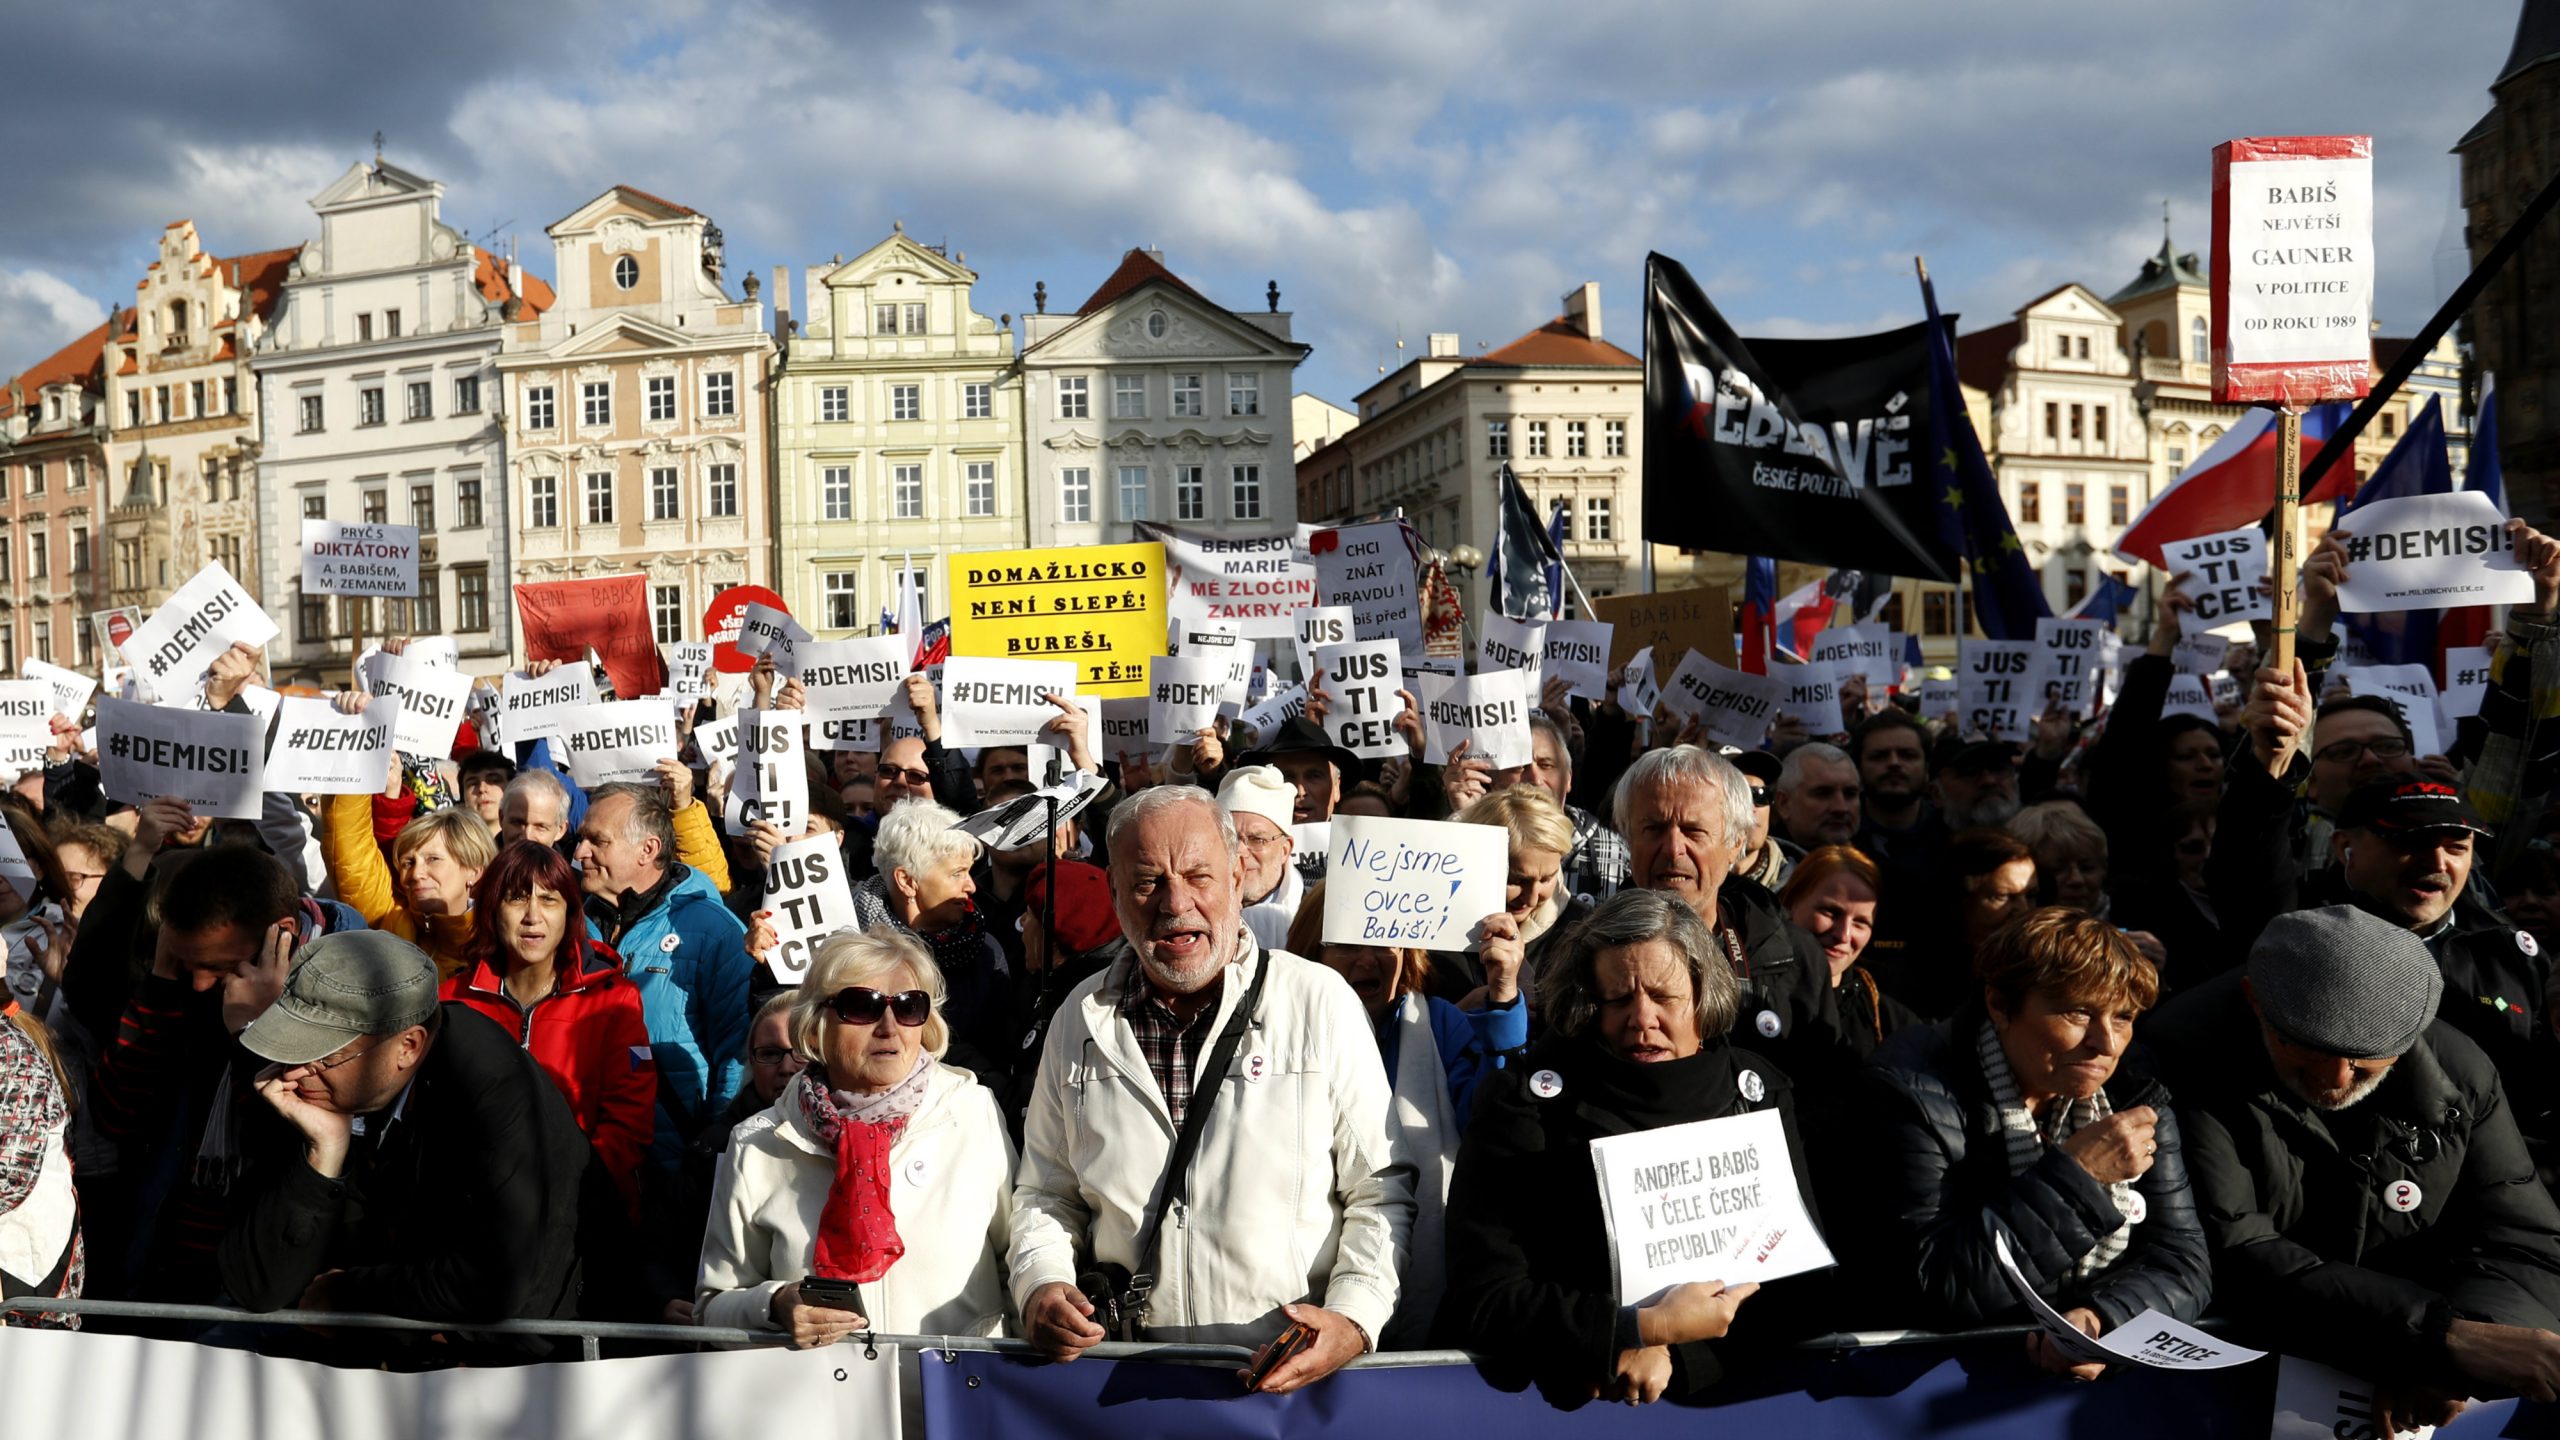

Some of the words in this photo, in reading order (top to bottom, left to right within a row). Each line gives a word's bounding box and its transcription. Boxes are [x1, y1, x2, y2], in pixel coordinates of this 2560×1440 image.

[2268, 180, 2337, 205] BABIŠ
[2262, 213, 2341, 232] NEJVĚTŠÍ
[2252, 247, 2354, 266] GAUNER
[2255, 283, 2267, 296] V
[2271, 280, 2349, 295] POLITICE
[2244, 317, 2268, 331] OD
[2273, 316, 2320, 330] ROKU
[2325, 315, 2357, 329] 1989
[341, 526, 373, 538] PRYČ
[377, 528, 384, 539] S
[2347, 524, 2514, 562] #DEMISI!
[314, 540, 410, 560] DIKTÁTORY
[1346, 541, 1380, 557] CHCI
[2181, 537, 2252, 560] JUS
[323, 564, 336, 575] A.
[340, 563, 400, 579] BABIŠEM,
[968, 561, 1146, 584] DOMAŽLICKO
[1224, 559, 1289, 574] MARIE
[1346, 562, 1385, 580] ZNÁT
[2199, 560, 2240, 584] TI
[320, 578, 336, 588] M.
[340, 578, 406, 592] ZEMANEM
[1190, 578, 1220, 597] MÉ
[1333, 586, 1394, 605] PRAVDU
[971, 595, 1036, 616] NENÍ
[1054, 590, 1146, 612] SLEPÉ!
[2196, 586, 2259, 620] CE!
[1376, 608, 1406, 625] před
[149, 589, 239, 677] #DEMISI!
[1007, 630, 1112, 652] BUREŠI,
[1300, 619, 1344, 644] JUS
[2047, 629, 2093, 649] JUS
[677, 648, 707, 661] JUS
[1815, 640, 1882, 662] #DEMISI!
[1973, 652, 2028, 674] JUS
[683, 664, 699, 677] TI
[803, 661, 900, 687] #DEMISI!
[1331, 653, 1388, 682] JUS
[2056, 655, 2080, 676] TI
[509, 683, 580, 711] #DEMISI!
[1345, 686, 1377, 715] TI
[1679, 673, 1769, 718] #DEMISI!
[1784, 682, 1833, 704] MISI!
[1984, 680, 2011, 703] TI
[1429, 700, 1517, 728] #DEMISI!
[288, 725, 387, 752] #DEMISI!
[571, 725, 668, 752] #DEMISI!
[746, 724, 790, 754] JUS
[823, 719, 867, 742] CE!
[1340, 720, 1393, 748] CE!
[109, 733, 249, 774] #DEMISI!
[752, 762, 778, 792] TI
[1341, 837, 1463, 881] Nejsme
[765, 853, 829, 895] JUS
[780, 894, 823, 930] TI
[1363, 916, 1448, 940] Babiši!
[780, 930, 840, 972] CE
[1726, 928, 1744, 961] PENTAX
[1634, 1157, 1704, 1194] ANDREJ
[1708, 1143, 1760, 1180] BABIŠ
[1641, 1205, 1654, 1229] V
[1660, 1193, 1706, 1226] ČELE
[1709, 1177, 1764, 1217] ČESKÉ
[1645, 1225, 1737, 1269] REPUBLIKY
[2145, 1330, 2221, 1361] PETICE
